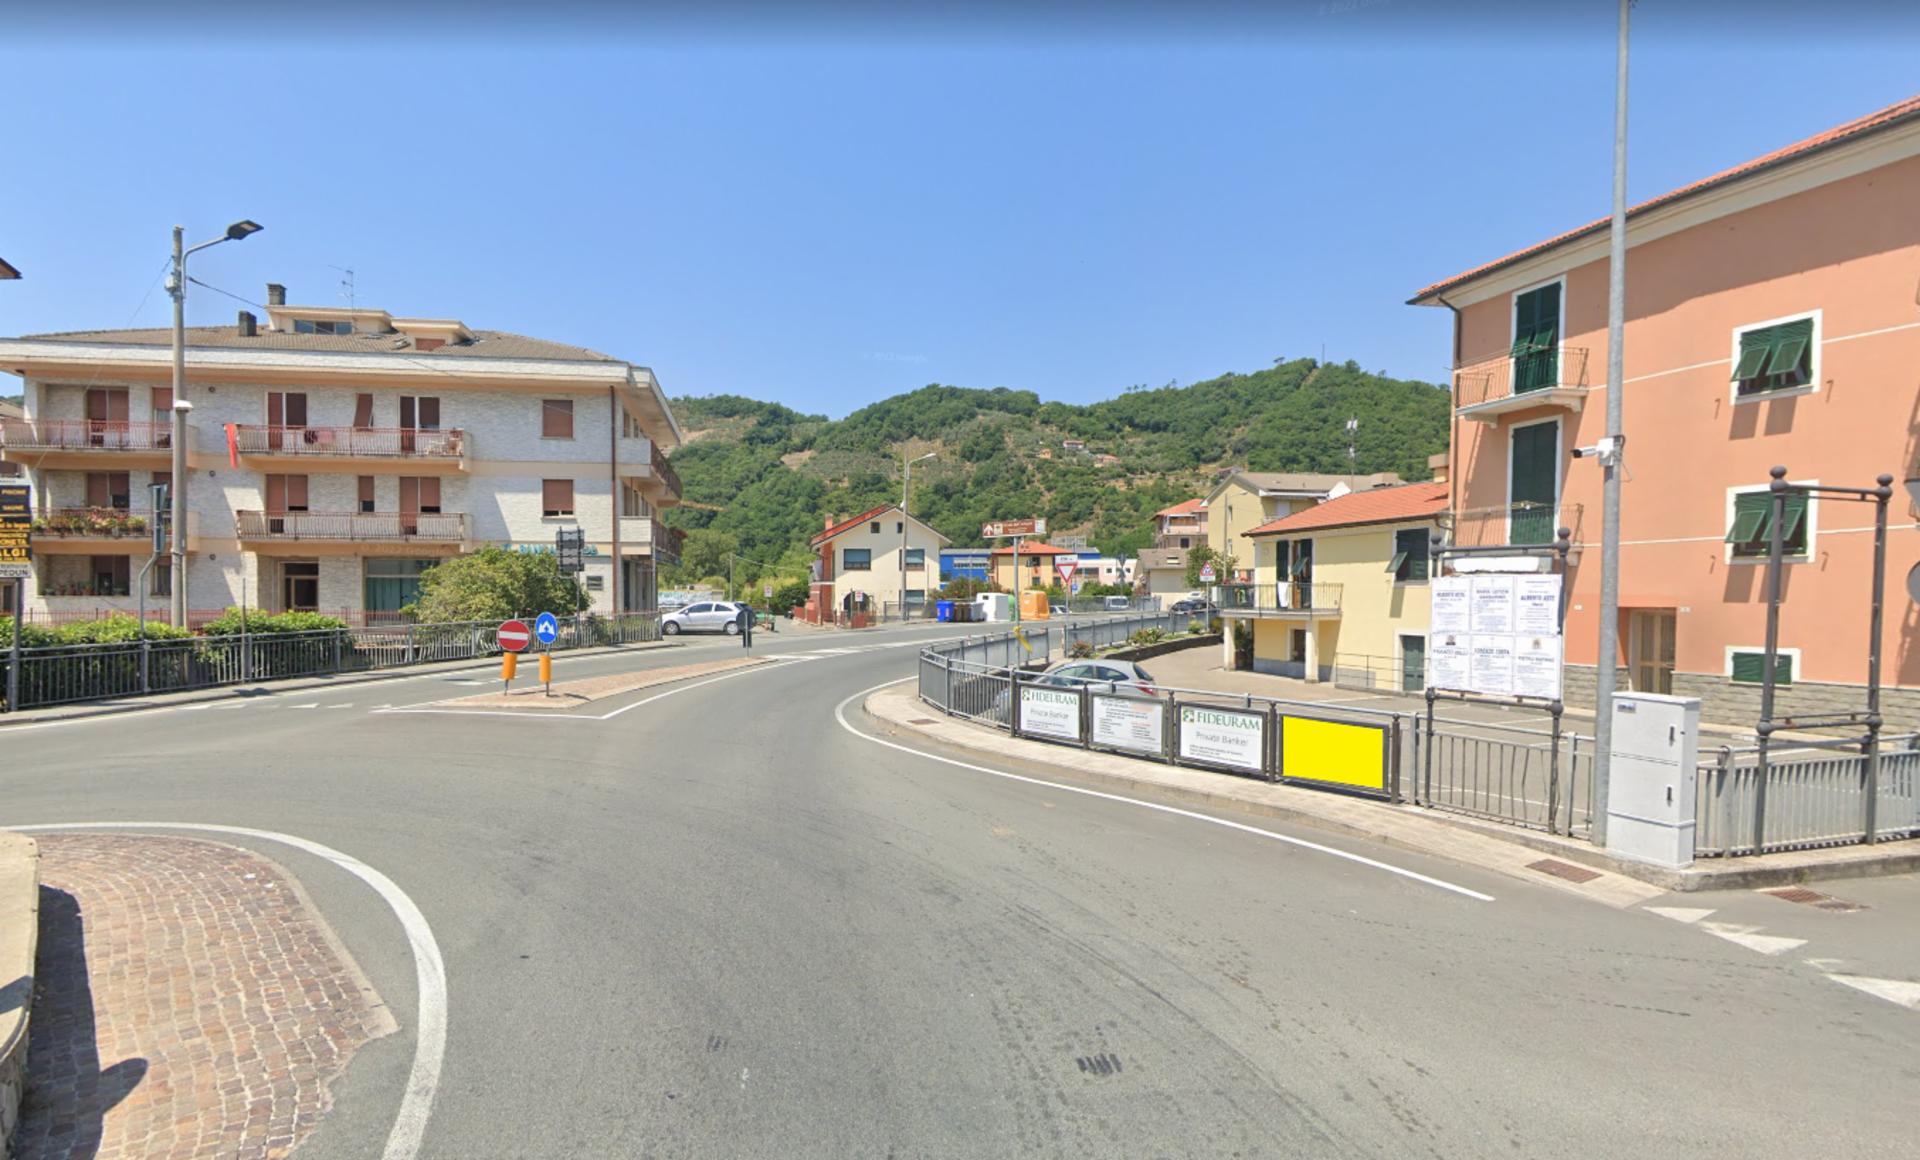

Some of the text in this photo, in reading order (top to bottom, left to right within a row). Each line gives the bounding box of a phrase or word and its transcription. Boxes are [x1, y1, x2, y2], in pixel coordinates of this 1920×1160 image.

[1032, 690, 1077, 706] FIDEURAM
[1197, 710, 1260, 731] FIDEURAM
[1195, 730, 1248, 747] Private Banker
